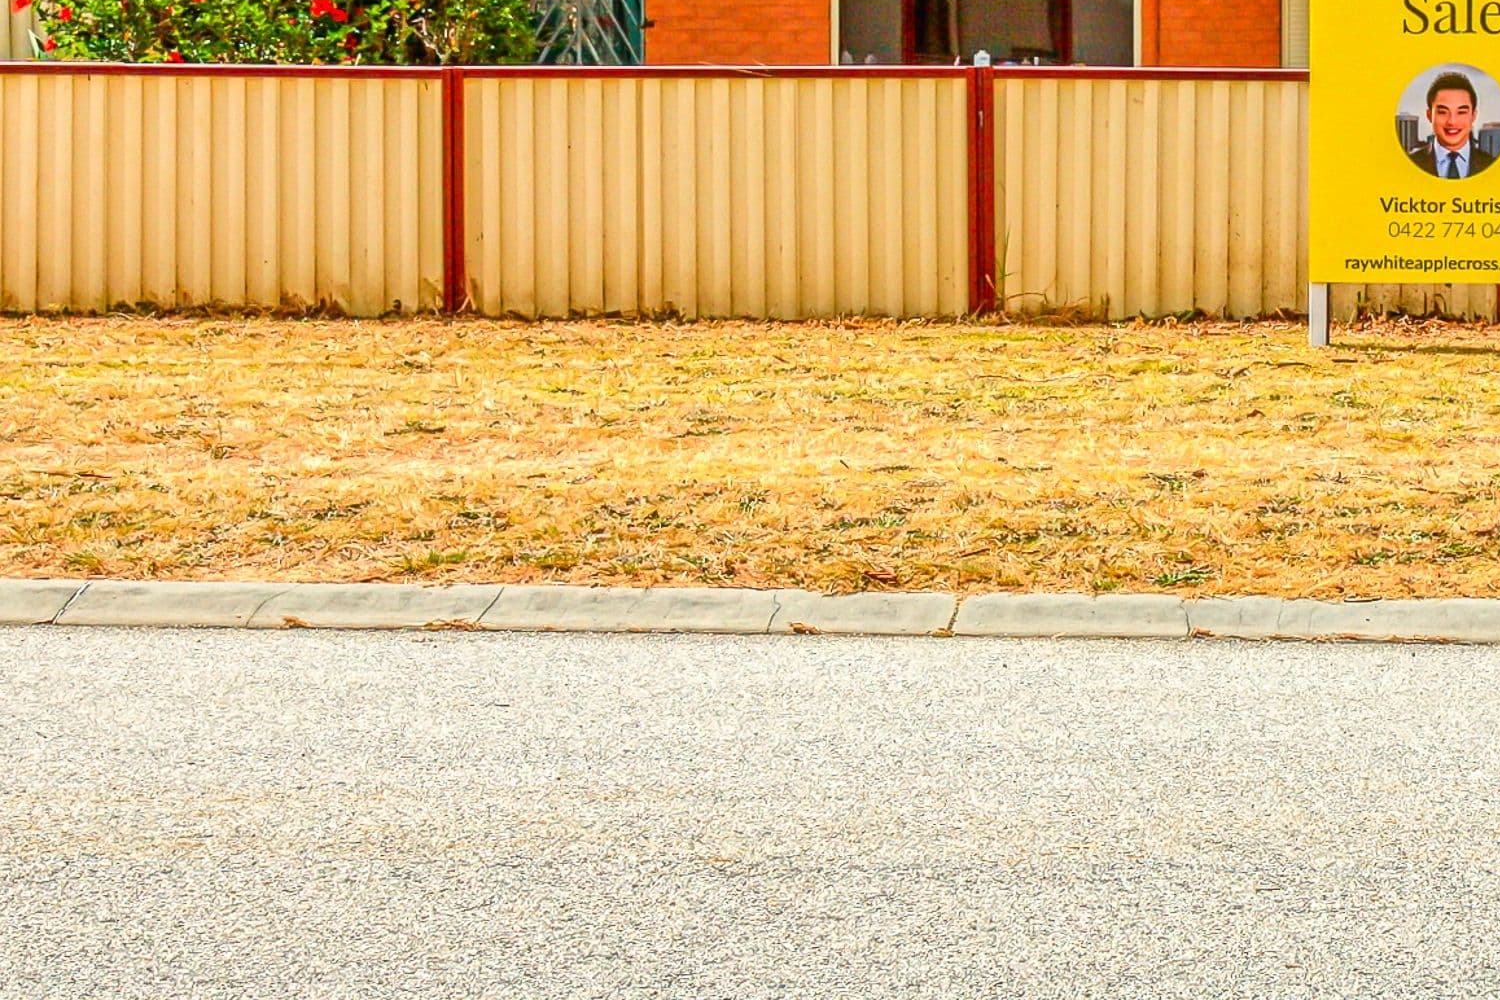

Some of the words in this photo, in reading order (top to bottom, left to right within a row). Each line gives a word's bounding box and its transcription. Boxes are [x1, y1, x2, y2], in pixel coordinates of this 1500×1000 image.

[1380, 197, 1446, 214] Vicktor
[1388, 222, 1435, 238] 0422
[1442, 222, 1476, 238] 774
